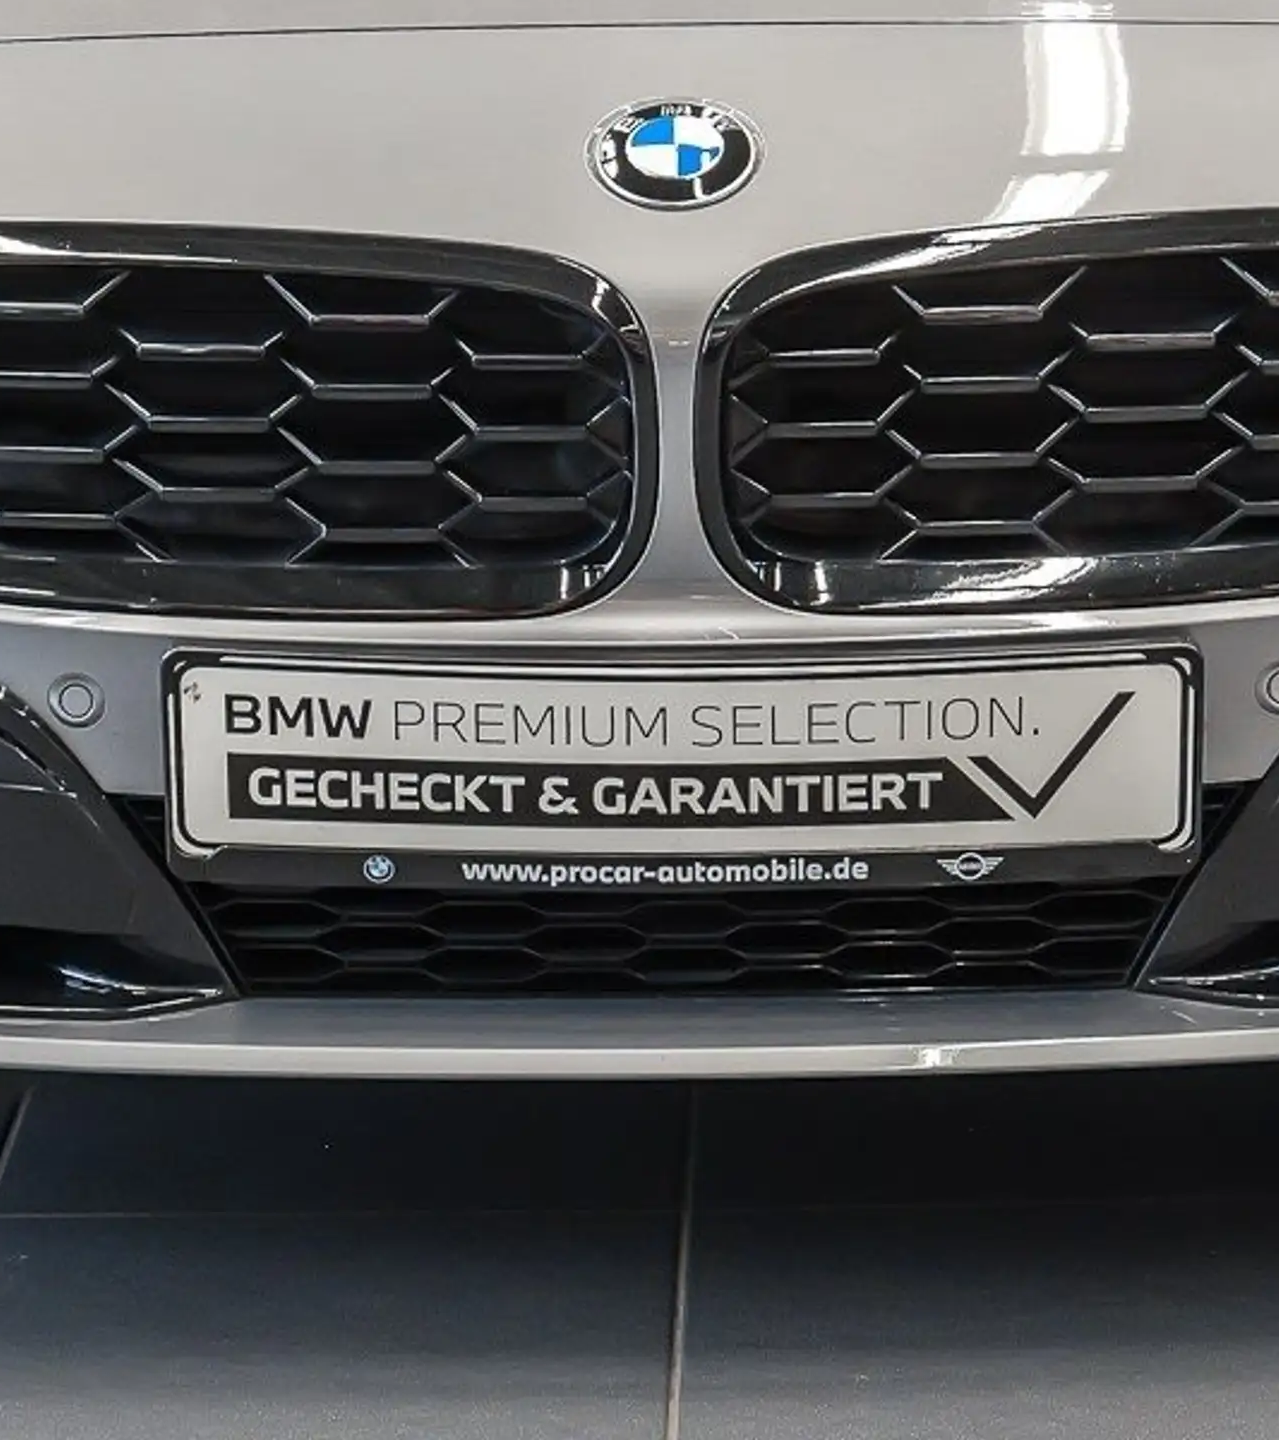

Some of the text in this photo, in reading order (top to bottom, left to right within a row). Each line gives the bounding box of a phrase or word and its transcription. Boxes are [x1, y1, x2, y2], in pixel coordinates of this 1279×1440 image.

[224, 693, 1041, 748] BMW PREMIUM SELECTION.
[248, 767, 944, 817] GECHECKT & GARANTIERT
[461, 856, 870, 887] www.procar-automobile.de
